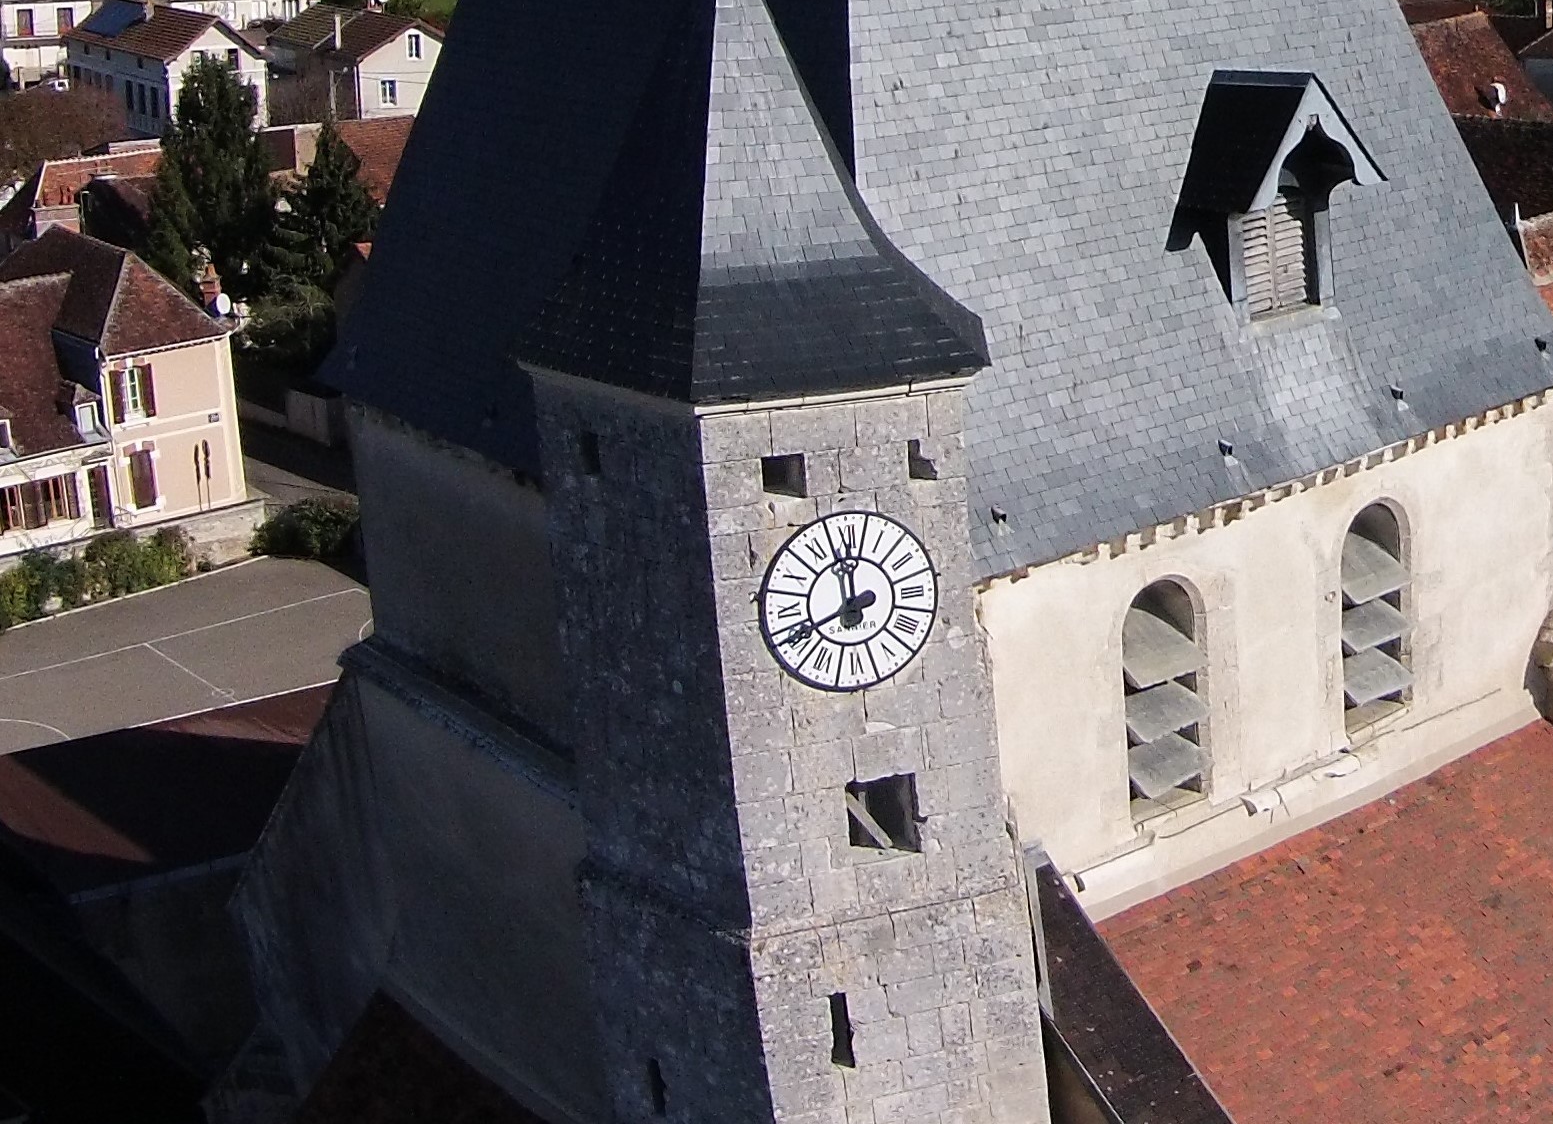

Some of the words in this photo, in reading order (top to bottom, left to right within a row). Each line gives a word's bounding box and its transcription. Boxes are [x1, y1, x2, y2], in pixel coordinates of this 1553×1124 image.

[805, 537, 828, 564] XI
[892, 552, 913, 571] II
[783, 567, 807, 587] X
[900, 585, 924, 599] III
[778, 601, 801, 619] IX
[894, 613, 919, 634] IIII
[813, 647, 831, 674] VII
[880, 641, 896, 662] V
[850, 650, 865, 676] VI
